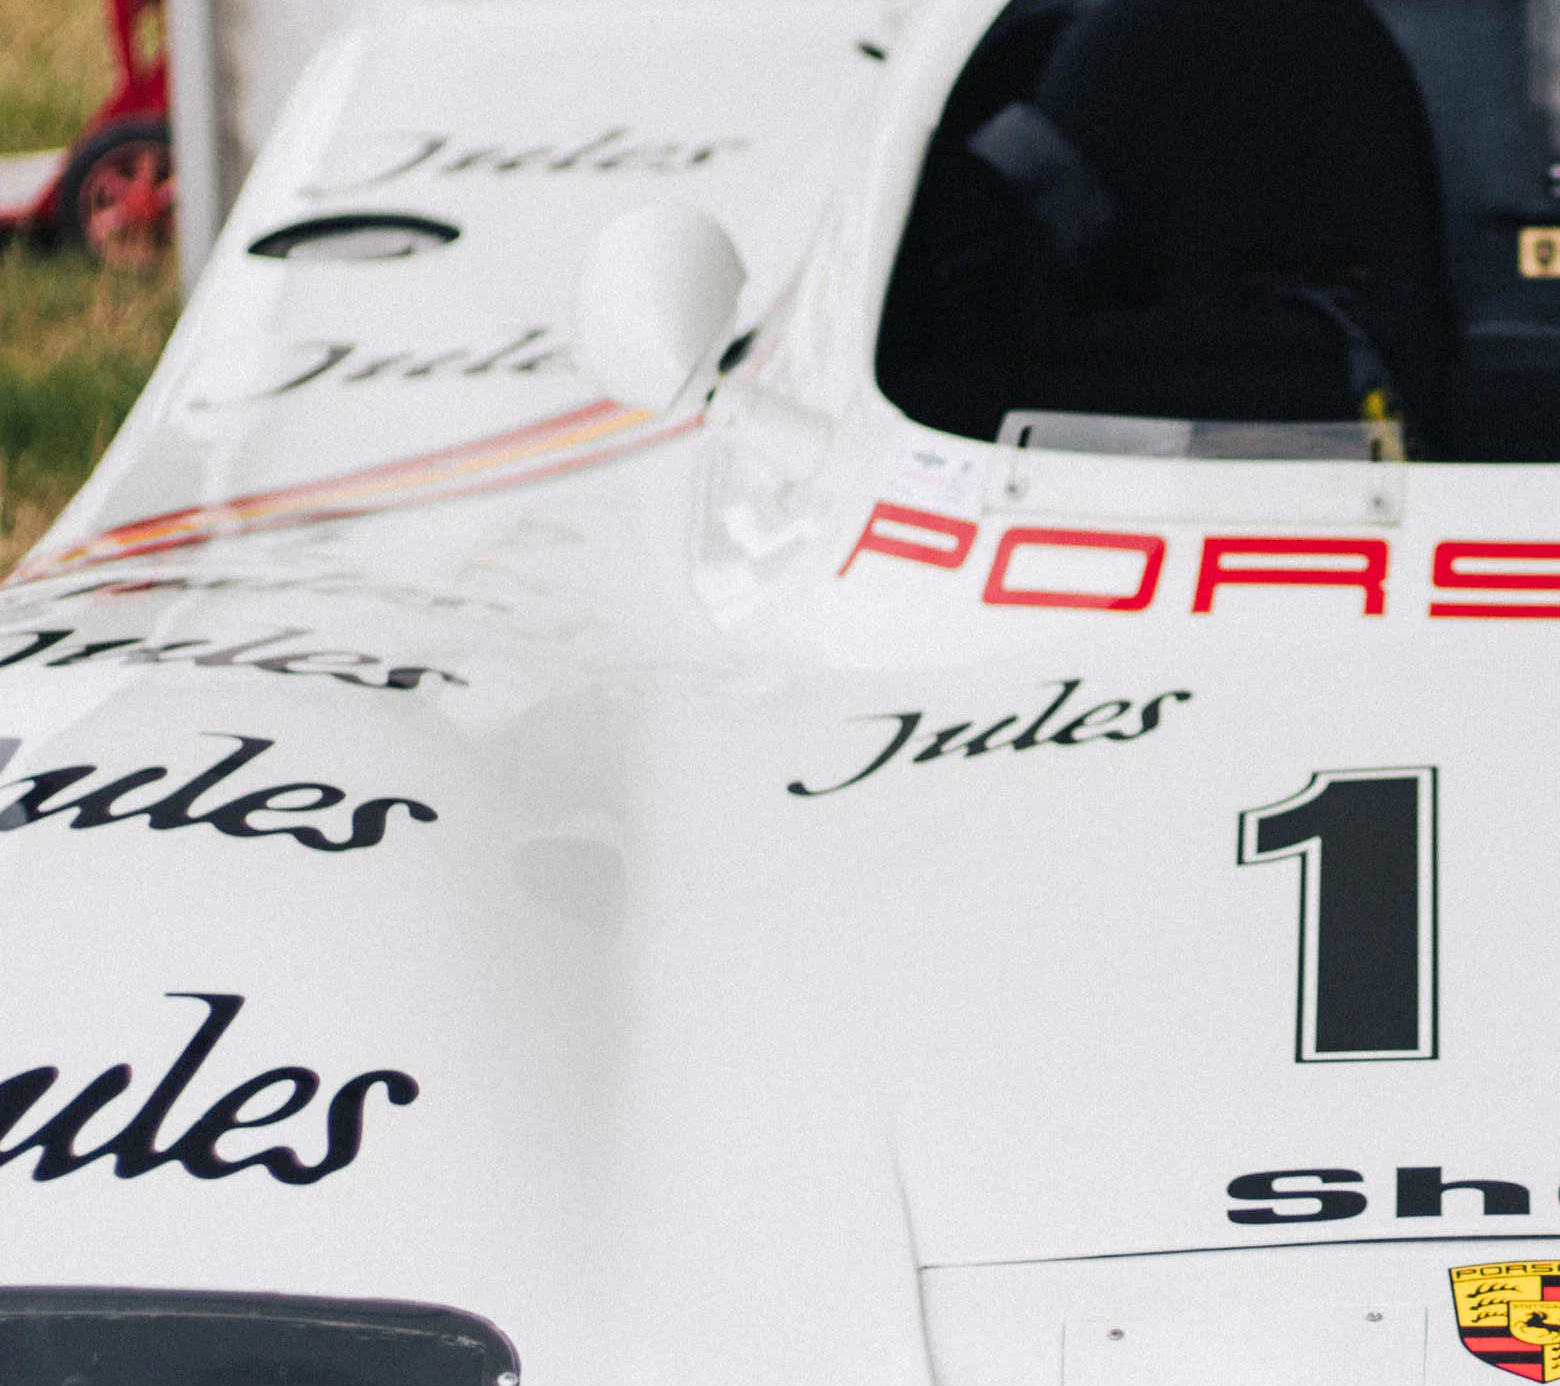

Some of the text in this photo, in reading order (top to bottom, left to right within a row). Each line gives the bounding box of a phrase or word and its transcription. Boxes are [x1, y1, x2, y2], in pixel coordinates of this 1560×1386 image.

[296, 126, 750, 199] Jules
[190, 326, 578, 410] Jule
[786, 677, 1195, 798] Jules
